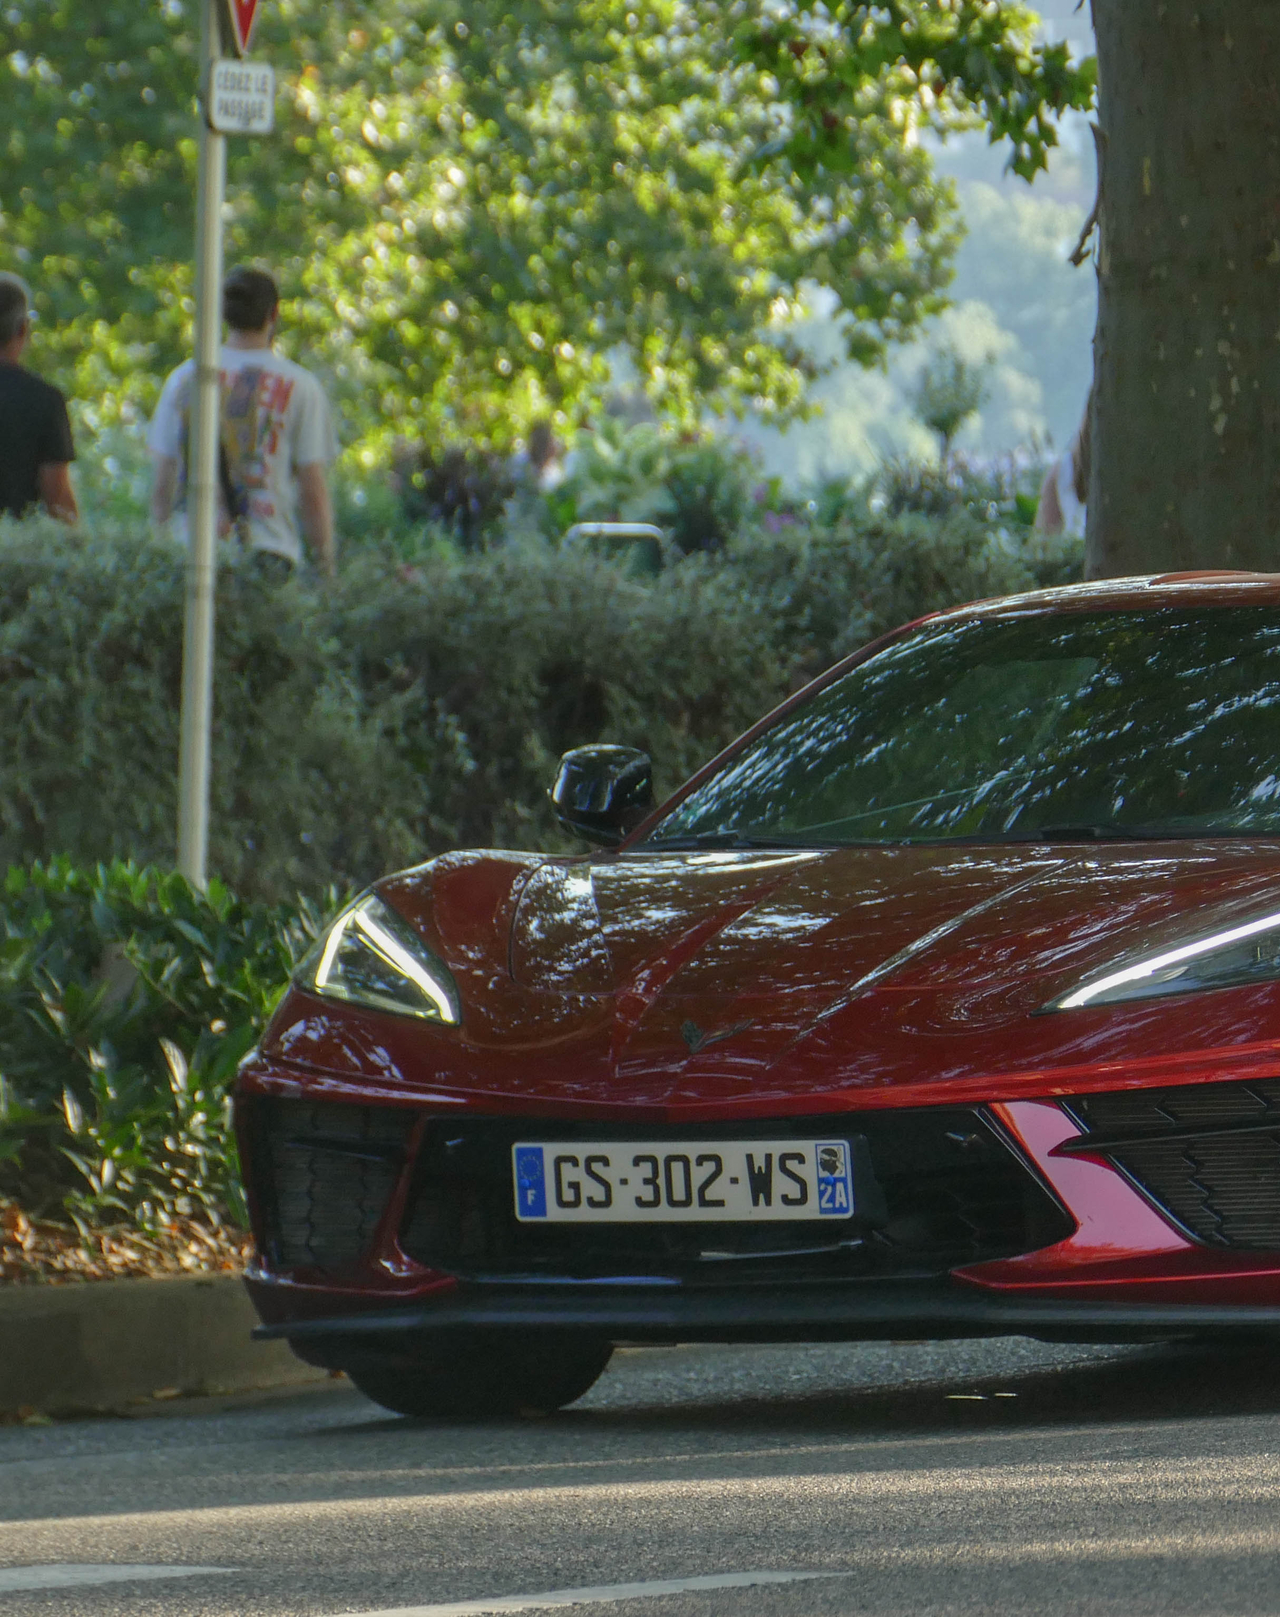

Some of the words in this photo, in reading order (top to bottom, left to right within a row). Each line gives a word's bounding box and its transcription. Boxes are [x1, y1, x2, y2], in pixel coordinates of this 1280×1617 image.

[553, 1152, 808, 1209] GS-302-WS
[526, 1189, 537, 1206] F
[819, 1182, 848, 1209] 2A
